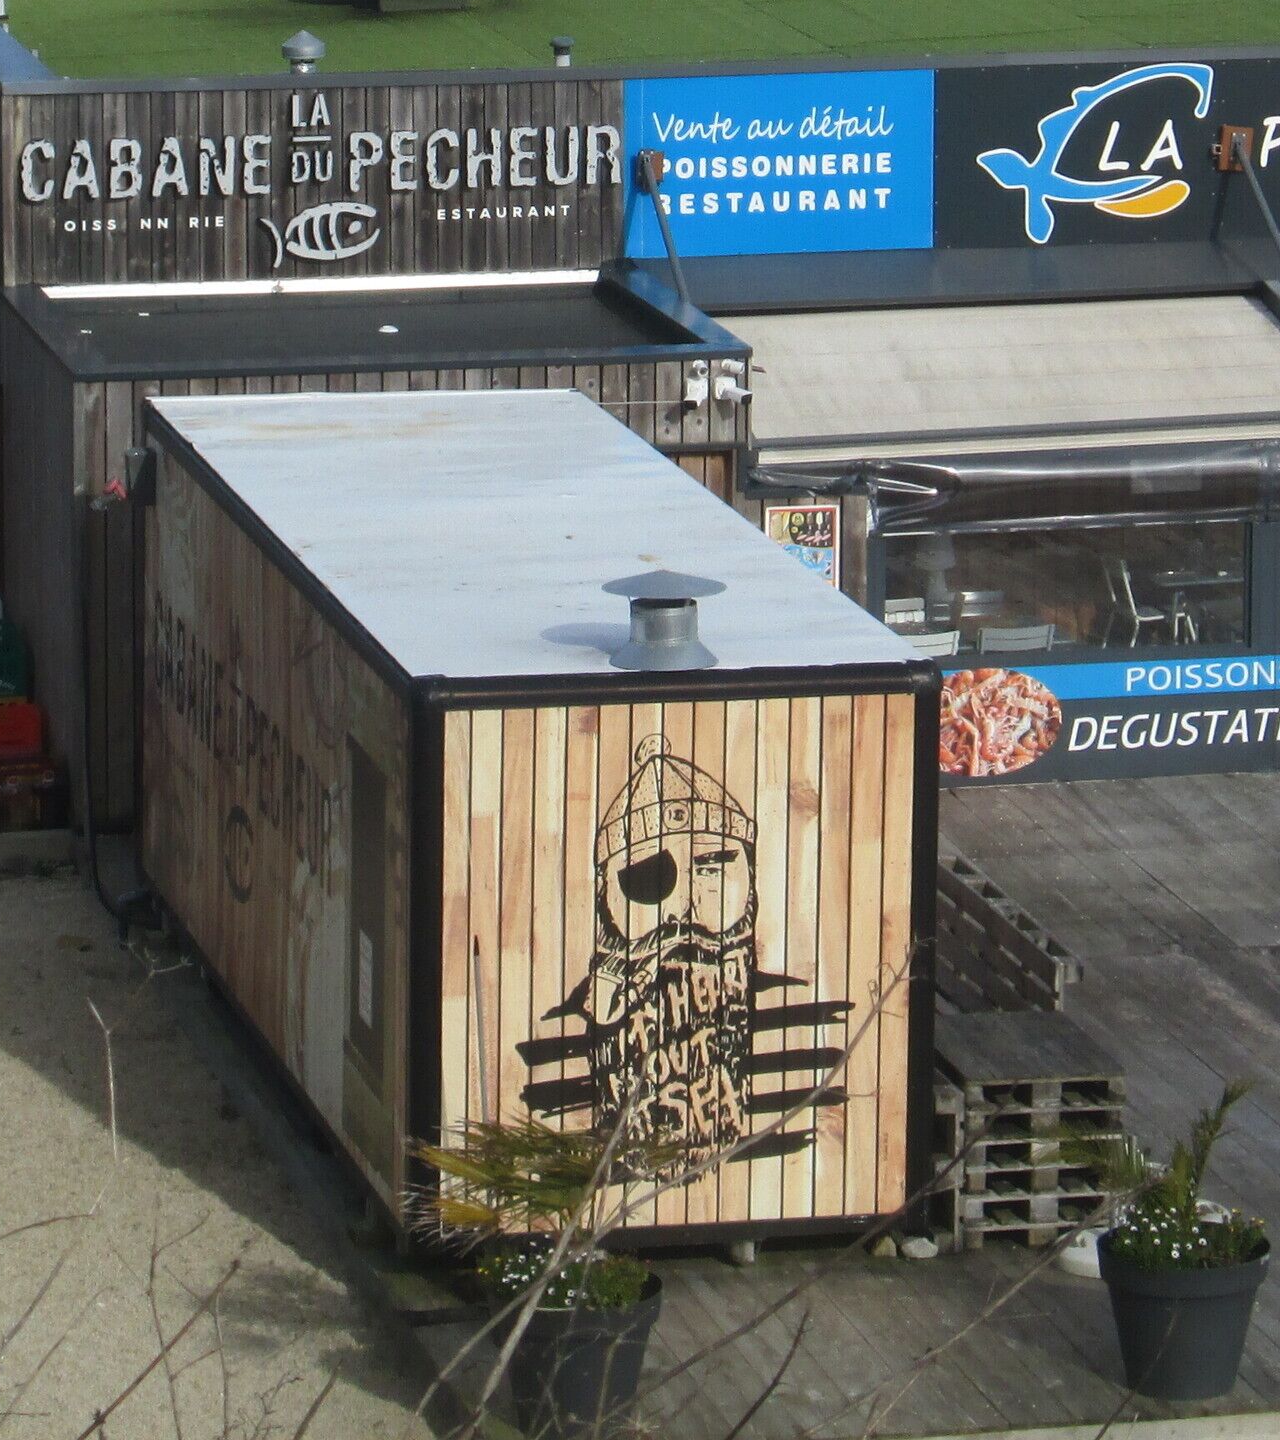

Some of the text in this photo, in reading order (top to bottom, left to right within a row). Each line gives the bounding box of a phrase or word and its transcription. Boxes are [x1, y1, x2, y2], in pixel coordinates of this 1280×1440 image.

[292, 94, 332, 128] LA
[652, 105, 895, 143] Vente au détail
[20, 133, 272, 202] CABANE
[291, 151, 333, 183] DU
[349, 124, 622, 193] PECHEUR
[1098, 120, 1184, 172] LA
